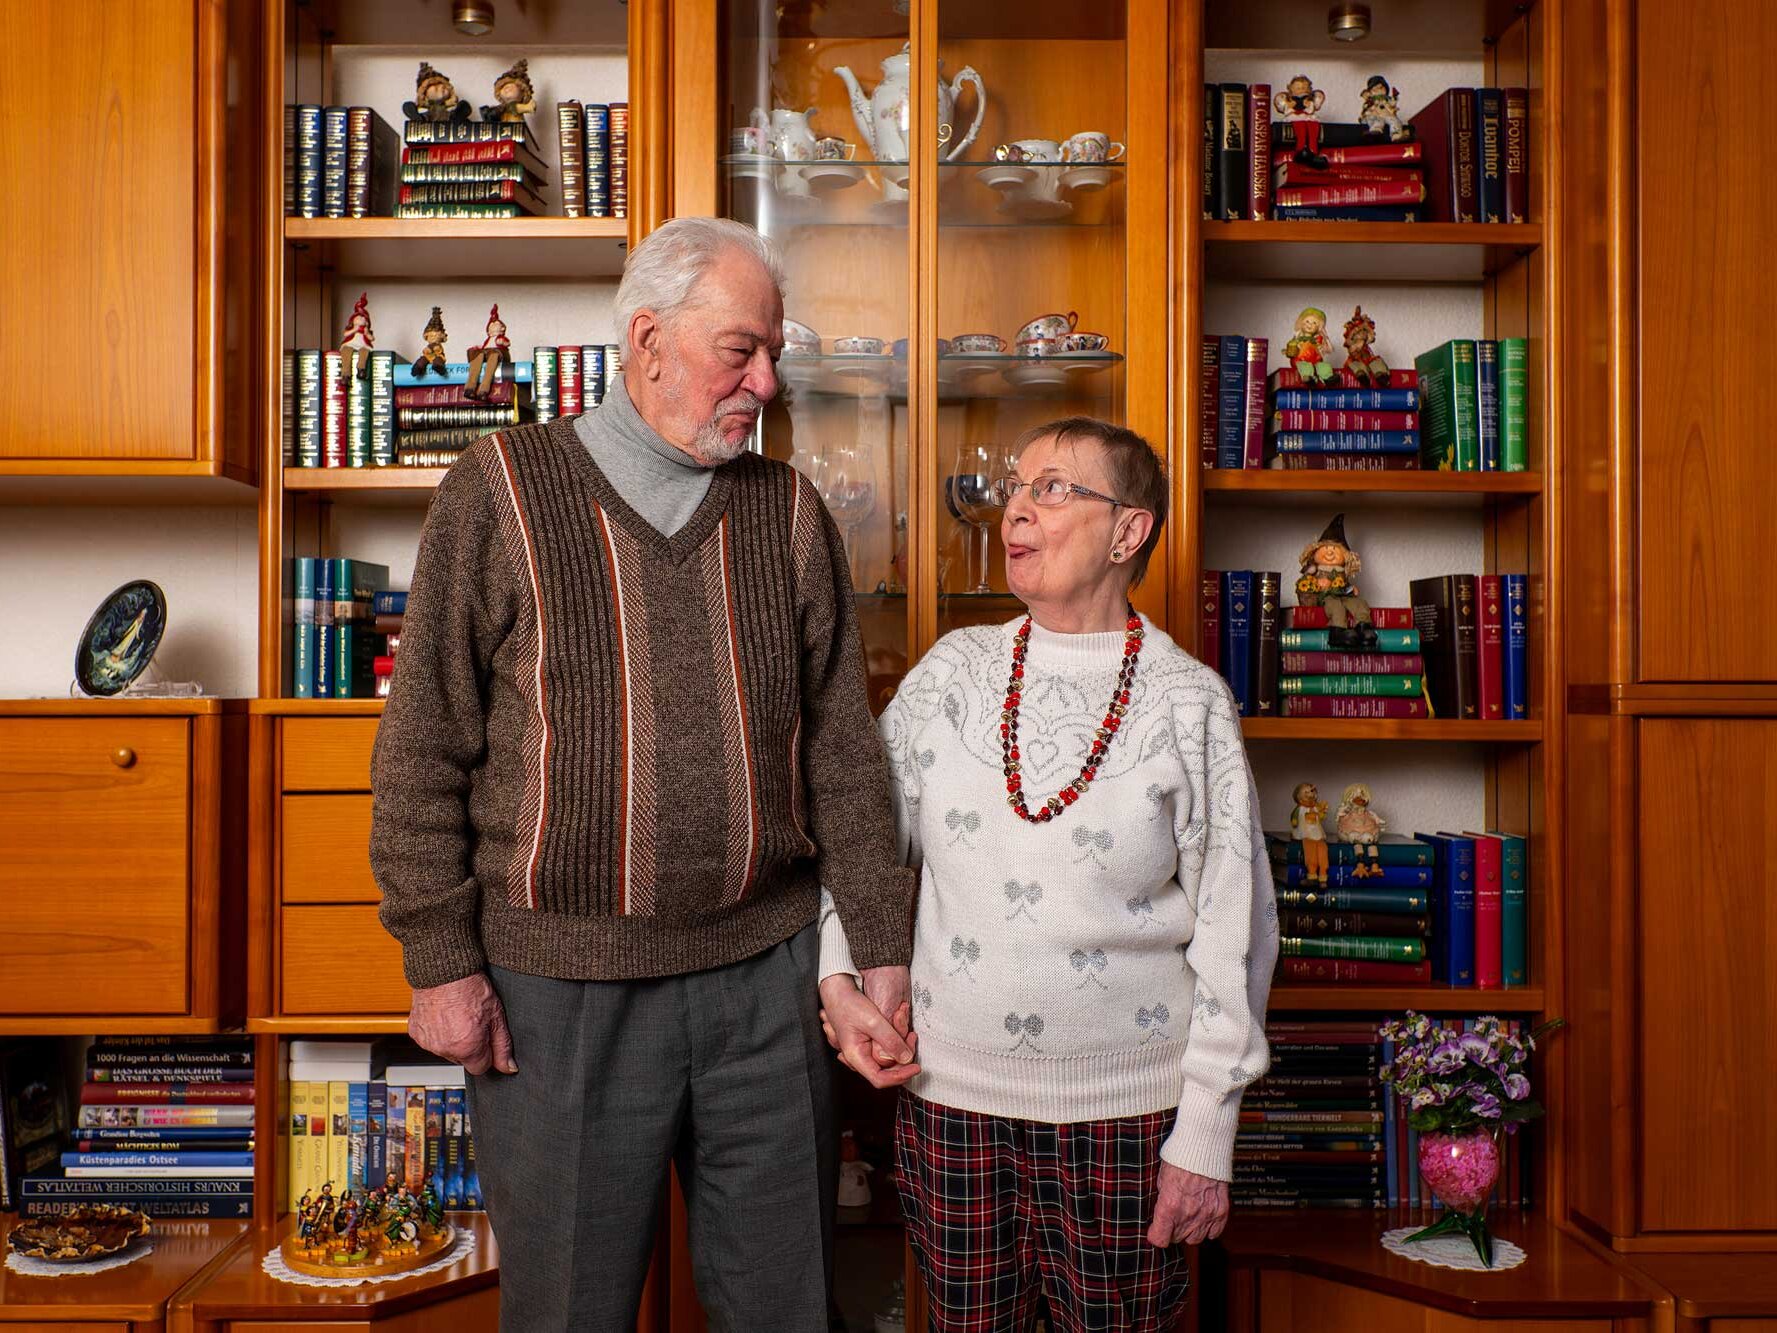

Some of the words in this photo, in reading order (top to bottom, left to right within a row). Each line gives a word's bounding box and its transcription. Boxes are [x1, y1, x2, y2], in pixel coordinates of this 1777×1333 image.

[1254, 109, 1268, 154] CASPAR
[1507, 119, 1521, 174] POMPEJI
[1254, 155, 1267, 199] HAUSER
[96, 1054, 116, 1063] 1000
[118, 1054, 147, 1065] Fragen
[149, 1055, 160, 1063] an
[162, 1054, 175, 1063] die
[176, 1053, 230, 1063] Wissenschaft
[79, 1156, 146, 1166] Küstenparadies
[149, 1156, 179, 1165] Ostsee
[352, 1136, 363, 1176] Kanada
[37, 1180, 103, 1193] WELTATLAS
[106, 1181, 191, 1193] HISTORISCHER
[194, 1182, 240, 1193] KNAURS
[140, 1202, 210, 1214] WELTATLAS
